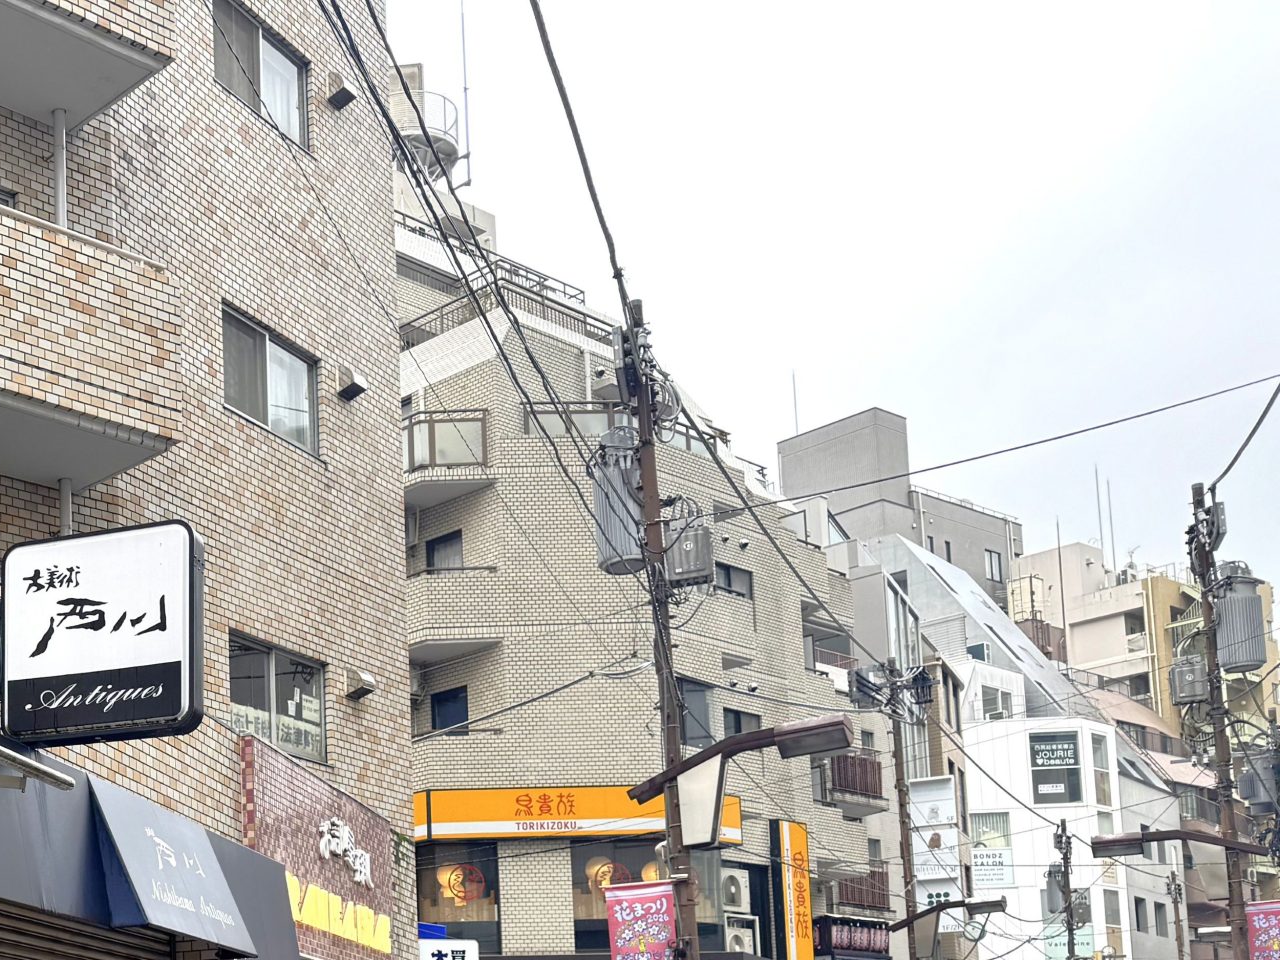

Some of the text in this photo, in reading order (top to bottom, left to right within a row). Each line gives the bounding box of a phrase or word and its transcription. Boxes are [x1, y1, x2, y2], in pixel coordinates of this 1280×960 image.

[22, 565, 81, 594] 古美術
[28, 594, 168, 658] 西川
[25, 682, 163, 713] Antiques
[1035, 750, 1075, 759] JOURIE
[514, 792, 577, 817] 鳥貴族
[515, 820, 578, 832] TORIKIZOKU
[973, 852, 1004, 860] BONDZ
[613, 897, 667, 922] 花まつり
[646, 914, 670, 923] 2026
[1252, 913, 1280, 929] 花ま
[1047, 940, 1091, 948] Valeine
